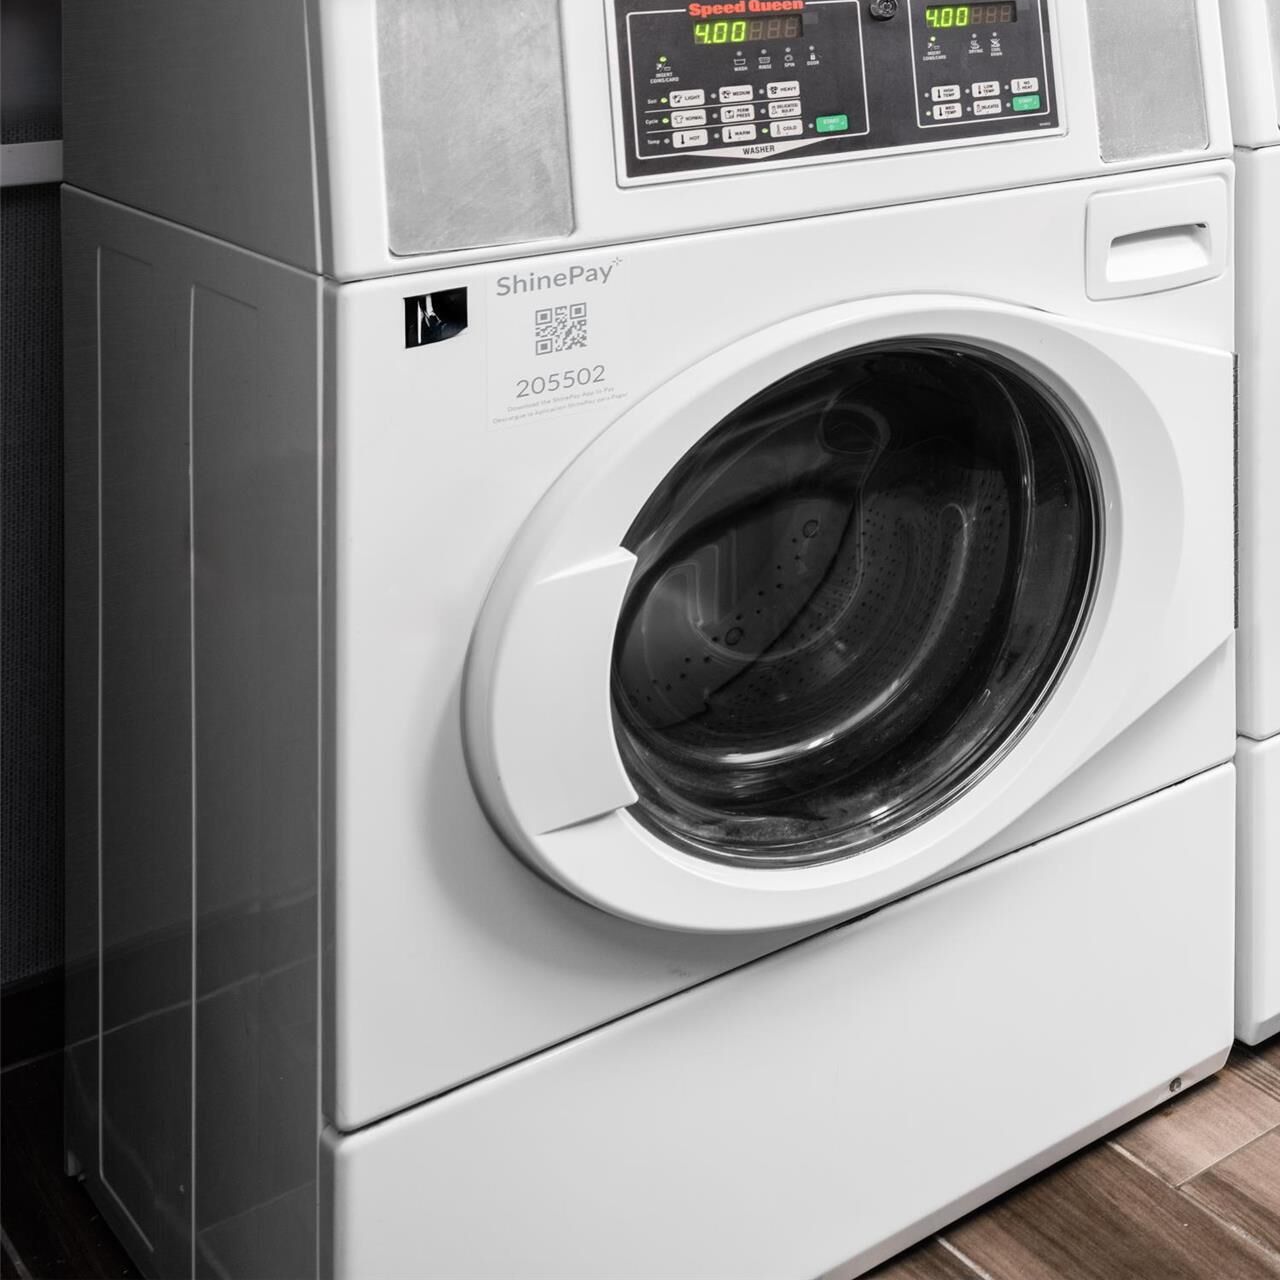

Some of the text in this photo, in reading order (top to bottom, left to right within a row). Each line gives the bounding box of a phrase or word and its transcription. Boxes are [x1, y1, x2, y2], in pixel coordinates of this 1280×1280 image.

[688, 0, 804, 17] Speed Queen
[926, 7, 968, 27] 4.00
[695, 21, 746, 44] 4.00
[742, 144, 775, 155] WASHER
[496, 265, 613, 296] ShinePay
[515, 365, 606, 398] 205502
